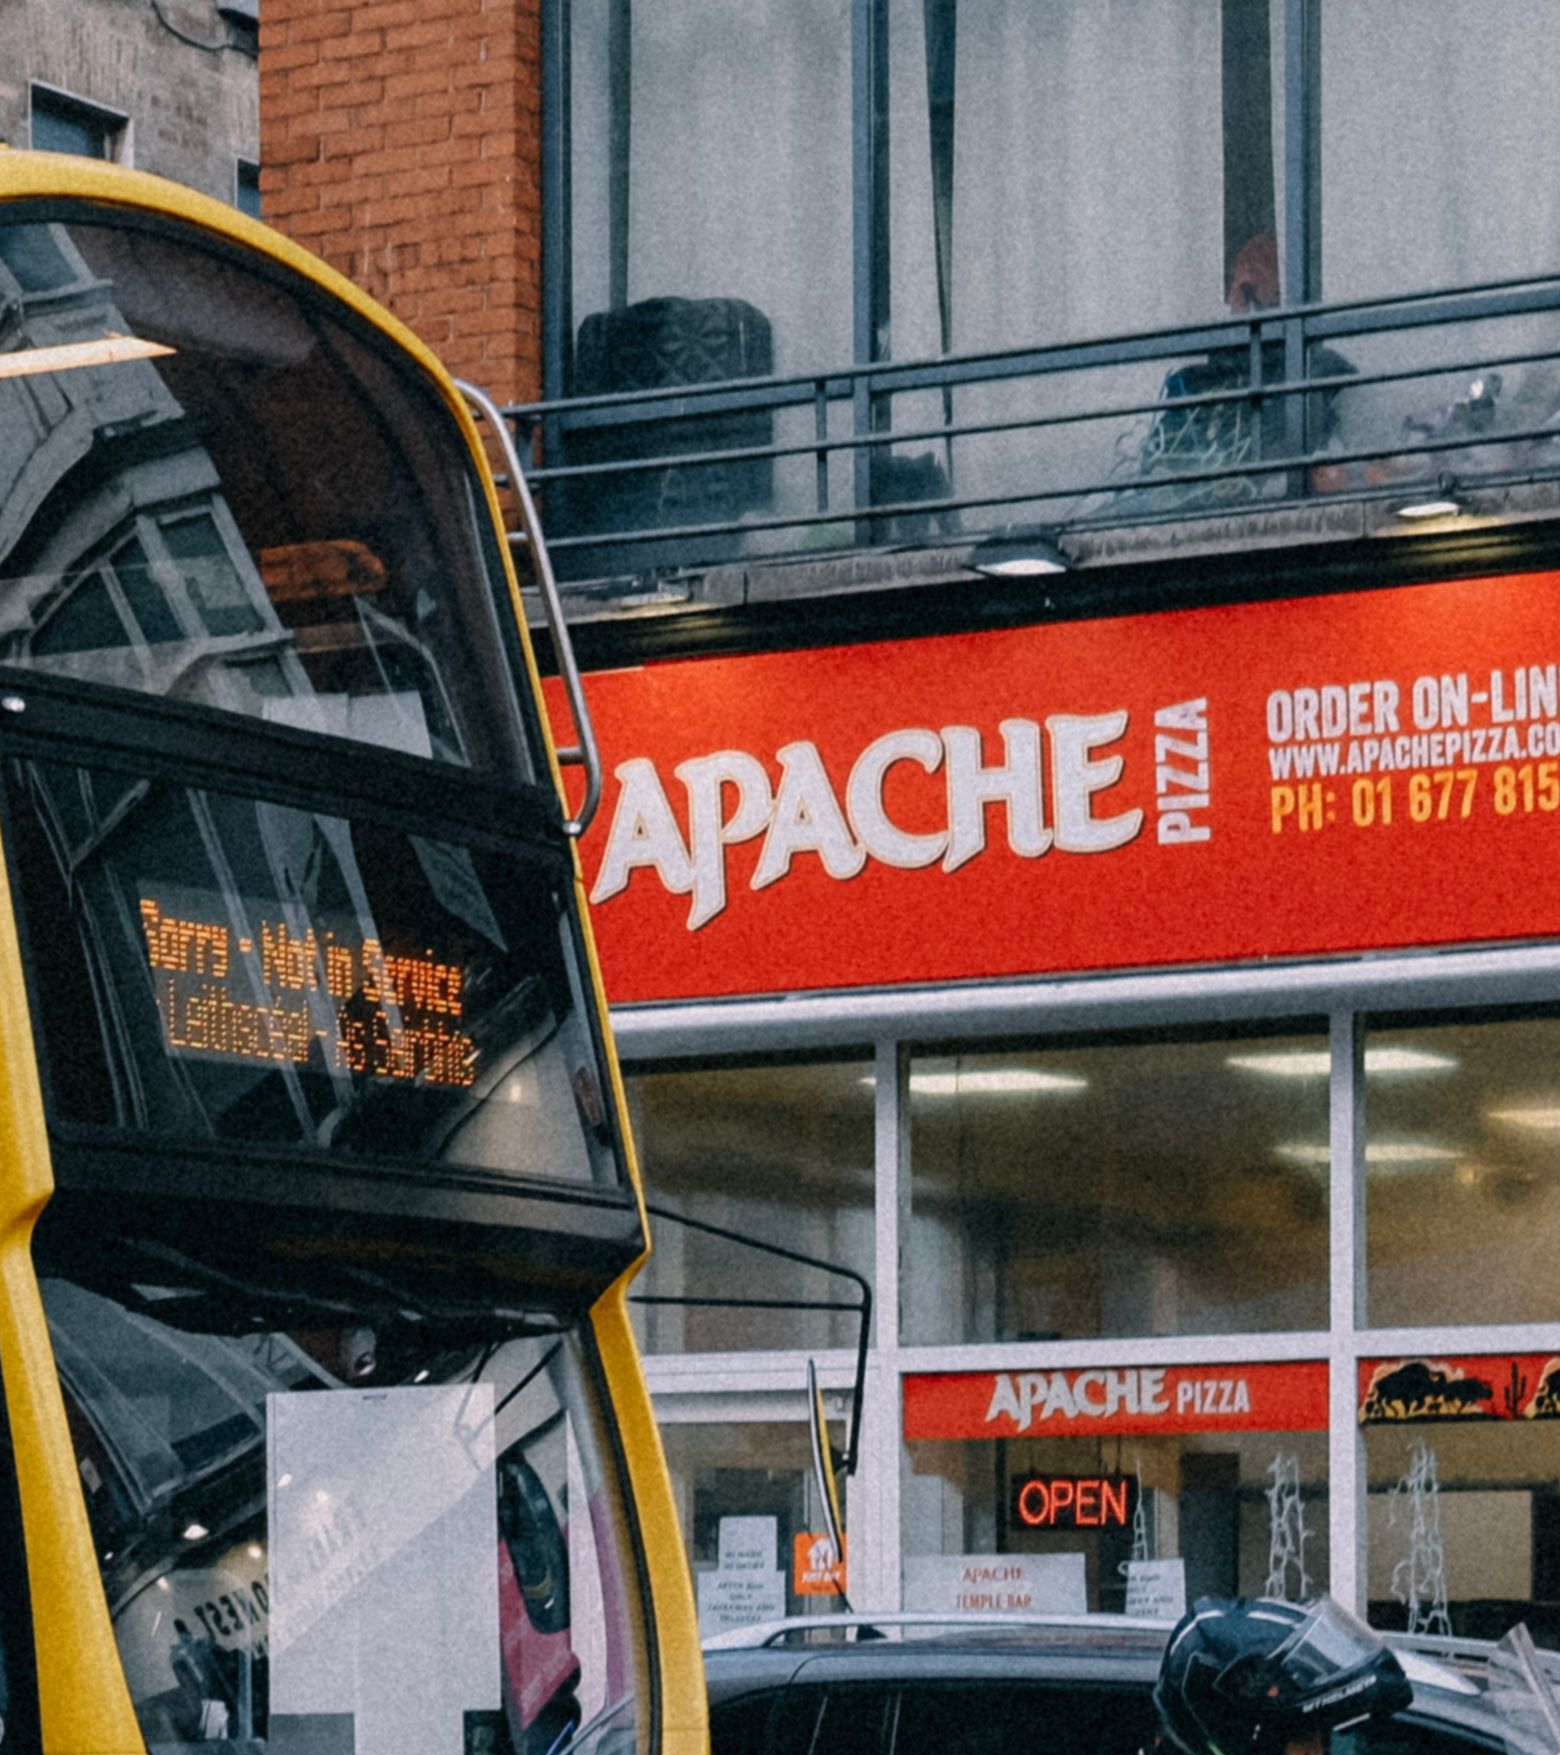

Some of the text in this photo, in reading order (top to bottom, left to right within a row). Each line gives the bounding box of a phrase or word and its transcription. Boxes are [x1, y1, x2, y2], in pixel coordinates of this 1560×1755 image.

[1266, 680, 1400, 743] ORDER
[1155, 696, 1212, 844] PIZZA
[1271, 783, 1336, 834] PH:
[1352, 776, 1392, 828] 01
[1409, 769, 1478, 823] 677
[590, 709, 1143, 931] APACHE
[261, 920, 318, 992] Not
[326, 931, 352, 998] in
[985, 1368, 1251, 1433] APACHE PIZZA
[1018, 1479, 1127, 1526] OPEN
[963, 1567, 1024, 1584] APACHE
